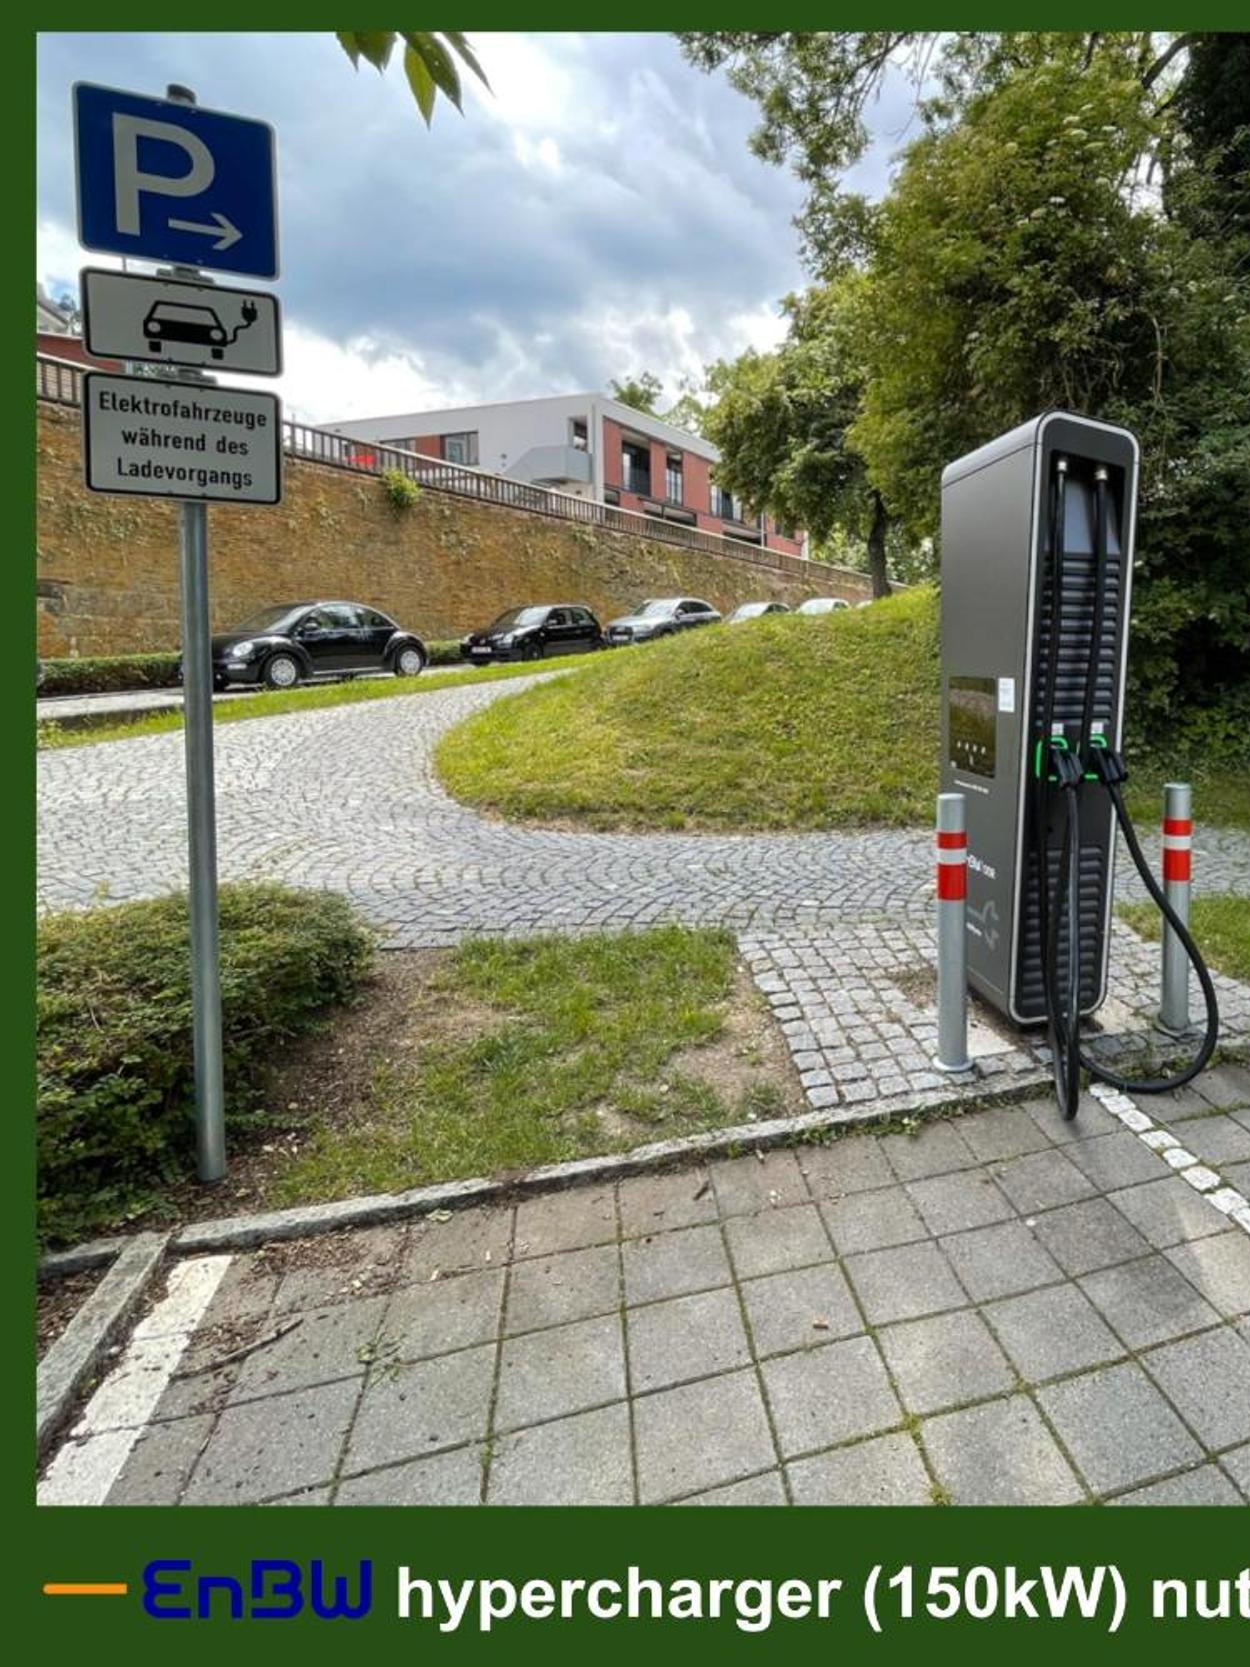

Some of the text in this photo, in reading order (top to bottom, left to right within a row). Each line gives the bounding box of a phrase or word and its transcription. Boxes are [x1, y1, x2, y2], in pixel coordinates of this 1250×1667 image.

[111, 112, 215, 236] P
[99, 391, 267, 430] Elektrofahrzeuge
[121, 427, 249, 456] während des
[117, 457, 253, 490] Ladevorgangs
